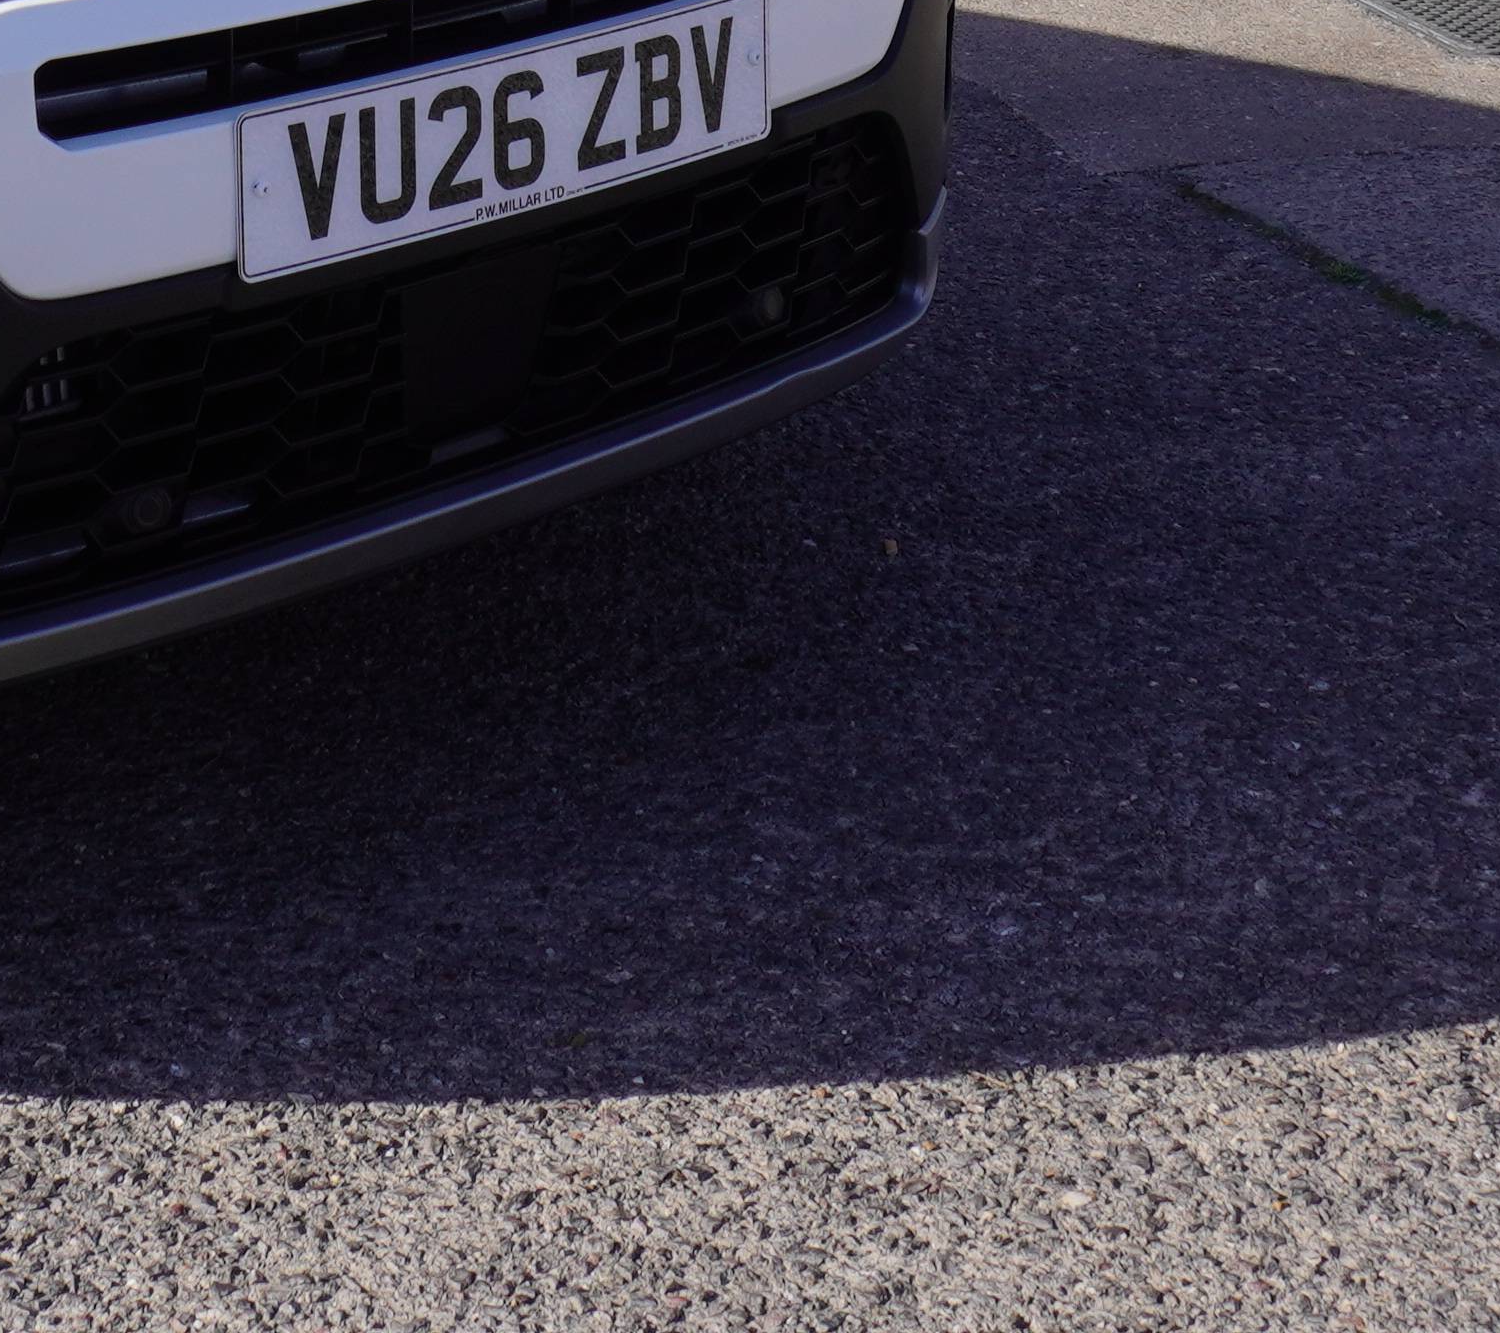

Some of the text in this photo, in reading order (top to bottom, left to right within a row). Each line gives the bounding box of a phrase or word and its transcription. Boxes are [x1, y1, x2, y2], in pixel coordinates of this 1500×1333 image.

[288, 16, 735, 241] VU26 ZBV
[544, 185, 565, 203] LTD
